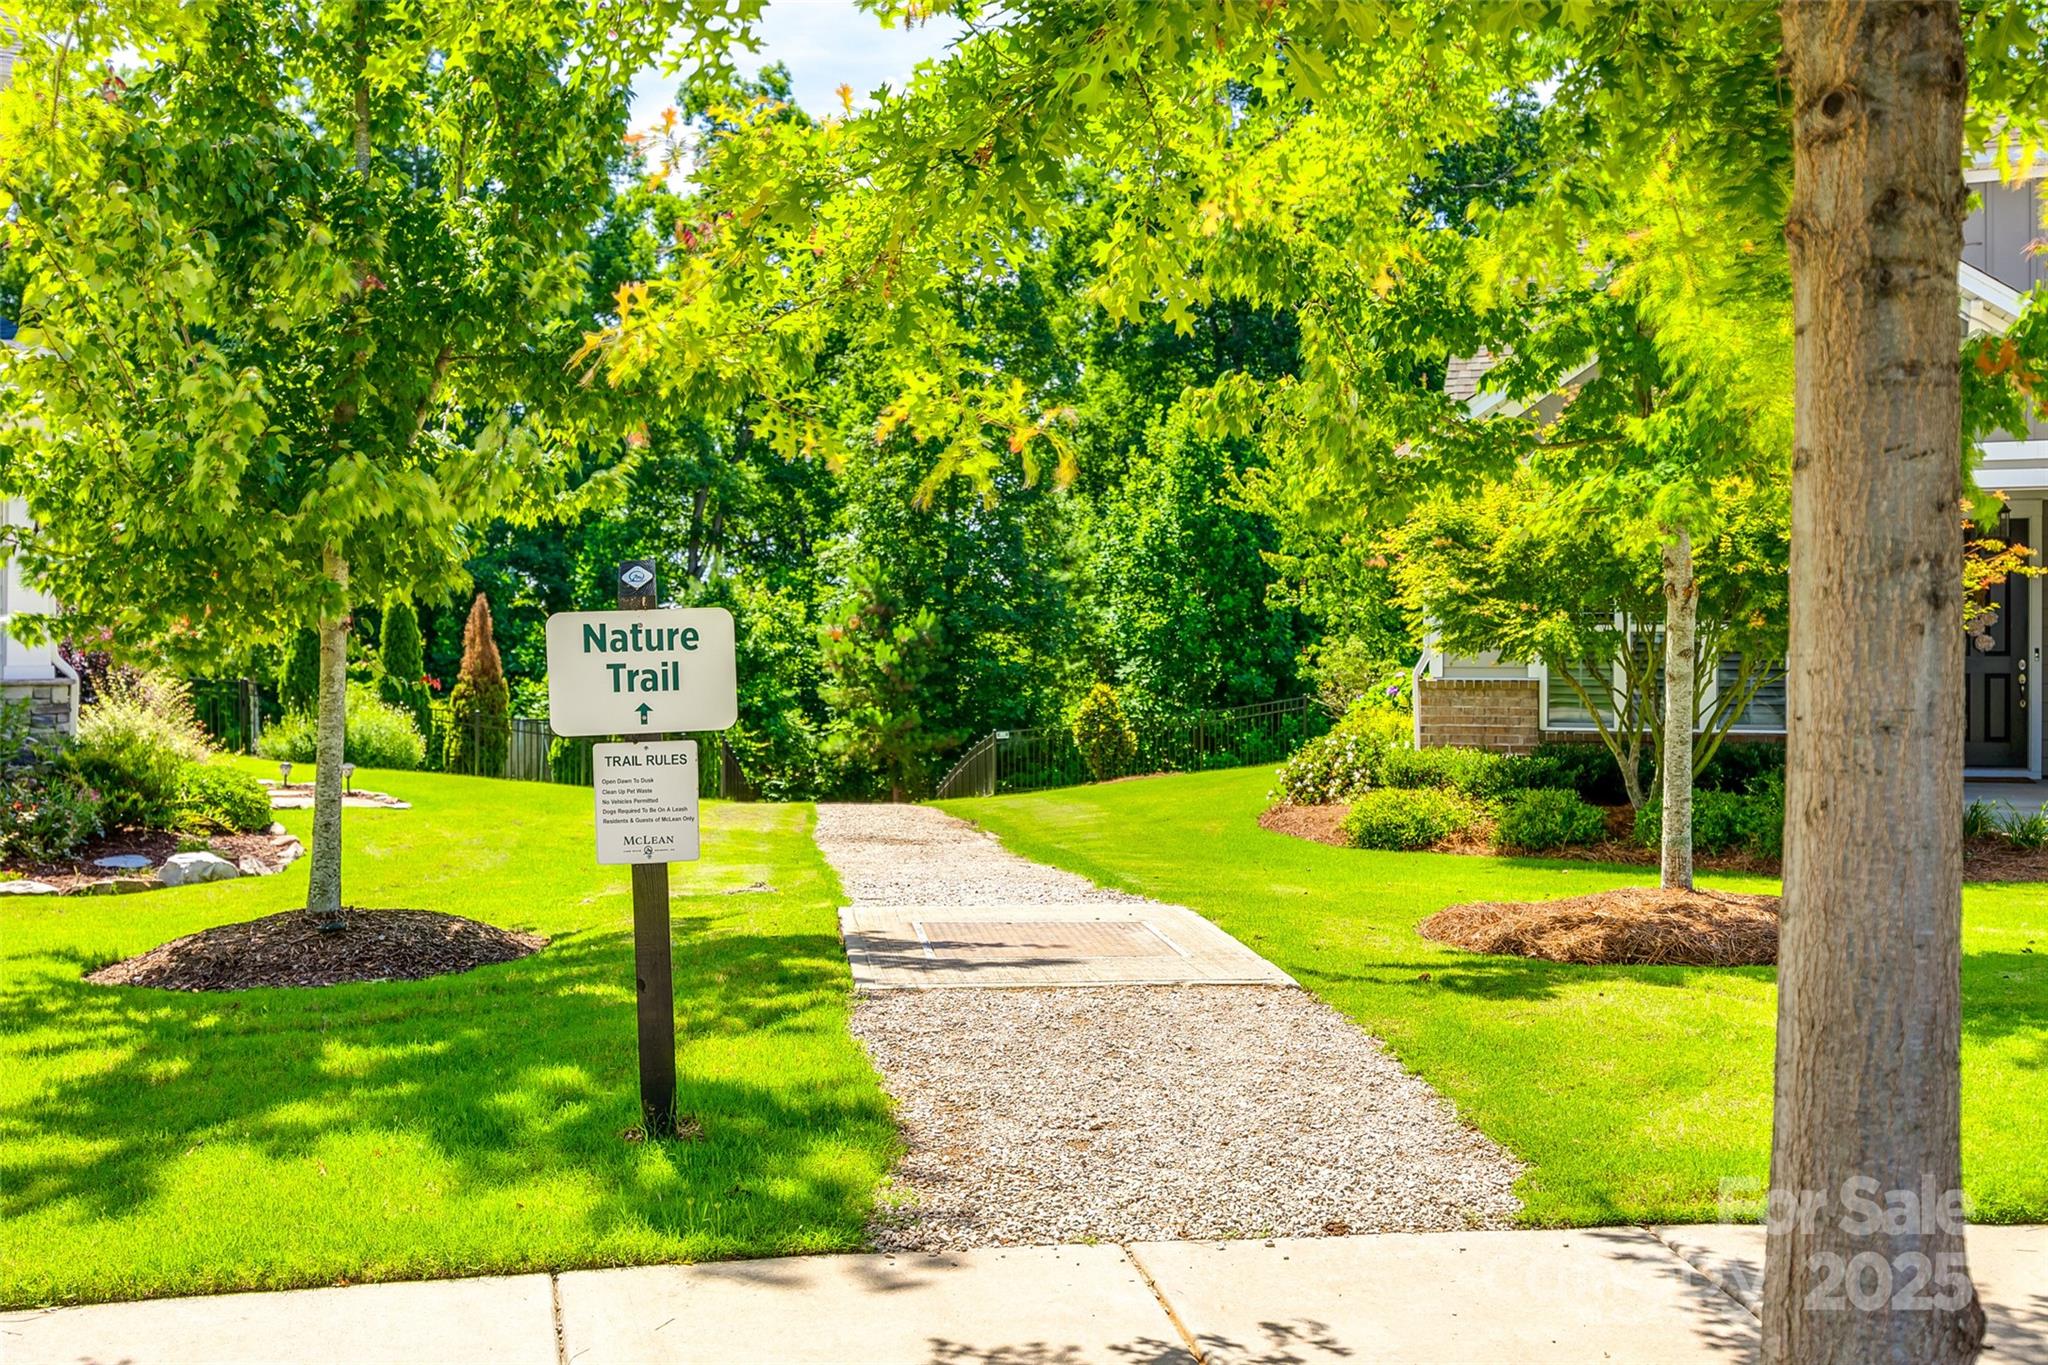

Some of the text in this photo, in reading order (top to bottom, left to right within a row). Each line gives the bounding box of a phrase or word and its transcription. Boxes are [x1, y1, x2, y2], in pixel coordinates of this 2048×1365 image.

[583, 623, 700, 653] Nature
[606, 661, 680, 692] Trail
[604, 753, 688, 767] TRAIL RULES
